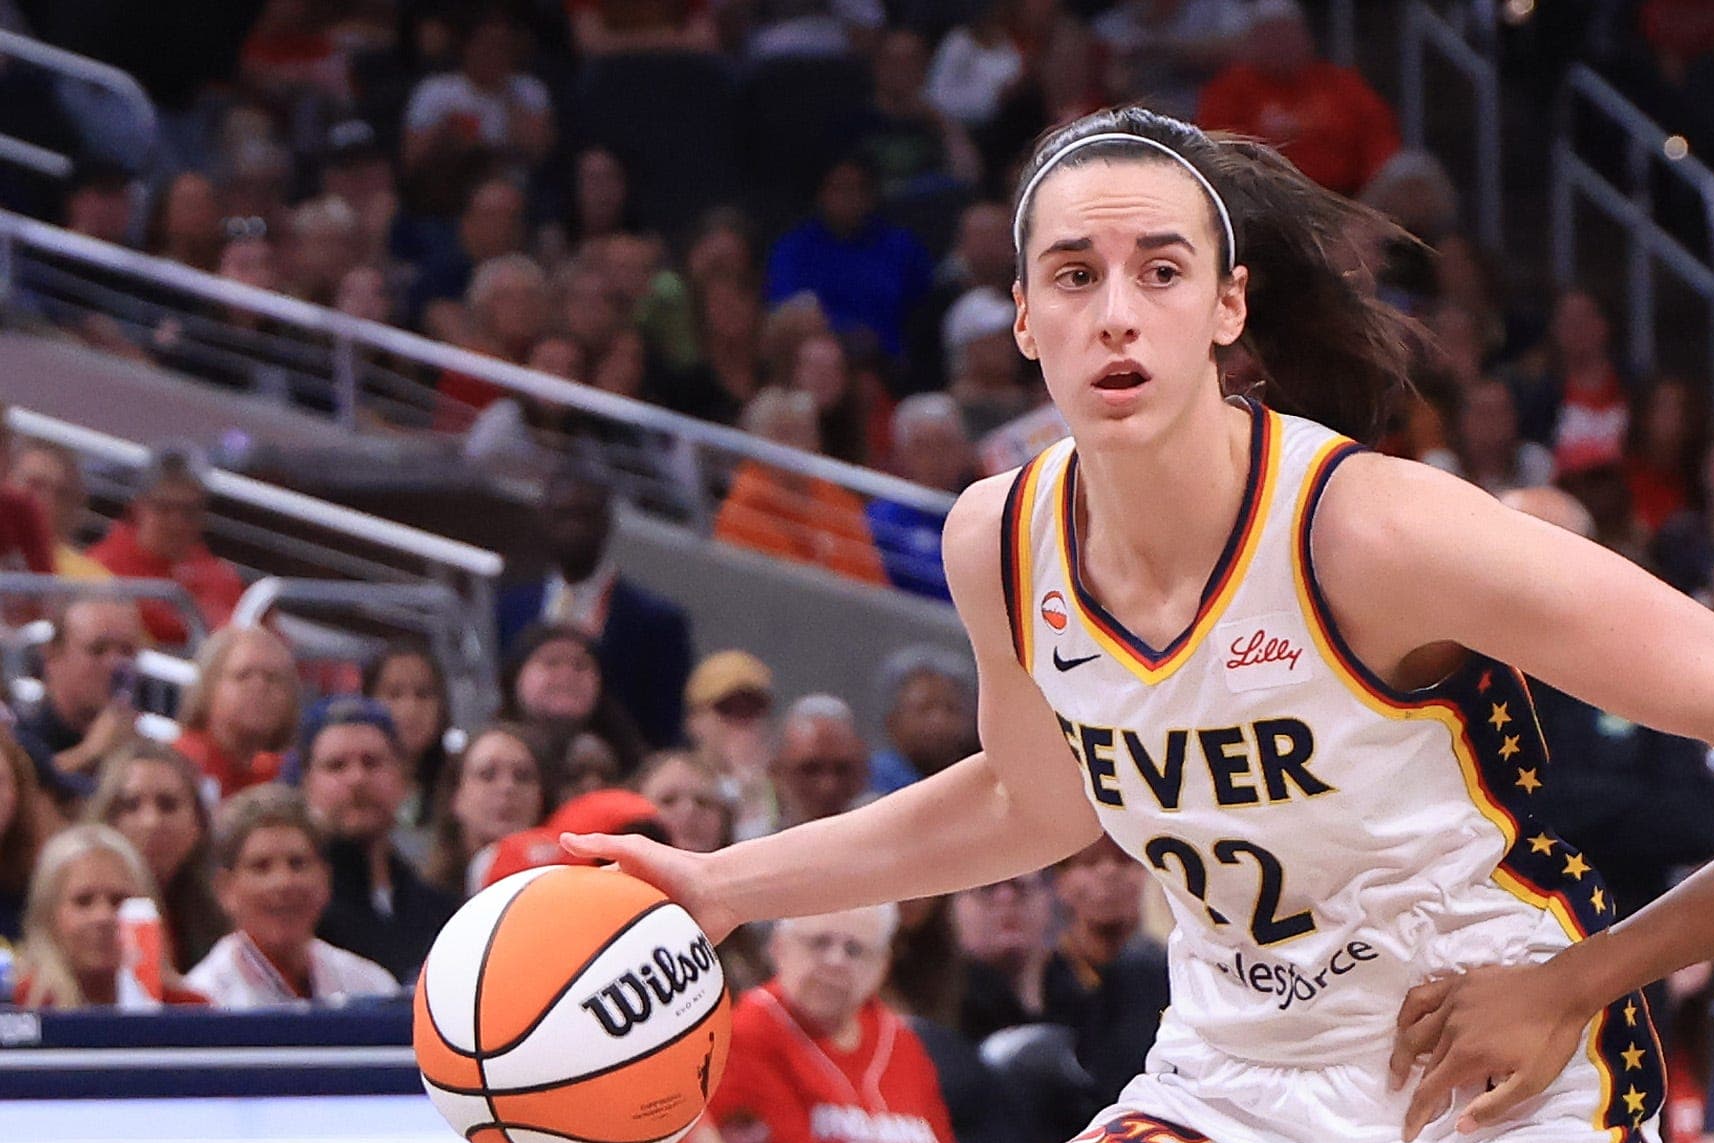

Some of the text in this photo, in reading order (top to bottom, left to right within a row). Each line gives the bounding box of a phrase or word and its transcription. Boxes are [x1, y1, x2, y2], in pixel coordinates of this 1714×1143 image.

[1226, 629, 1303, 671] Lilly
[579, 932, 717, 1037] Wilson
[1216, 940, 1380, 1010] lesforce
